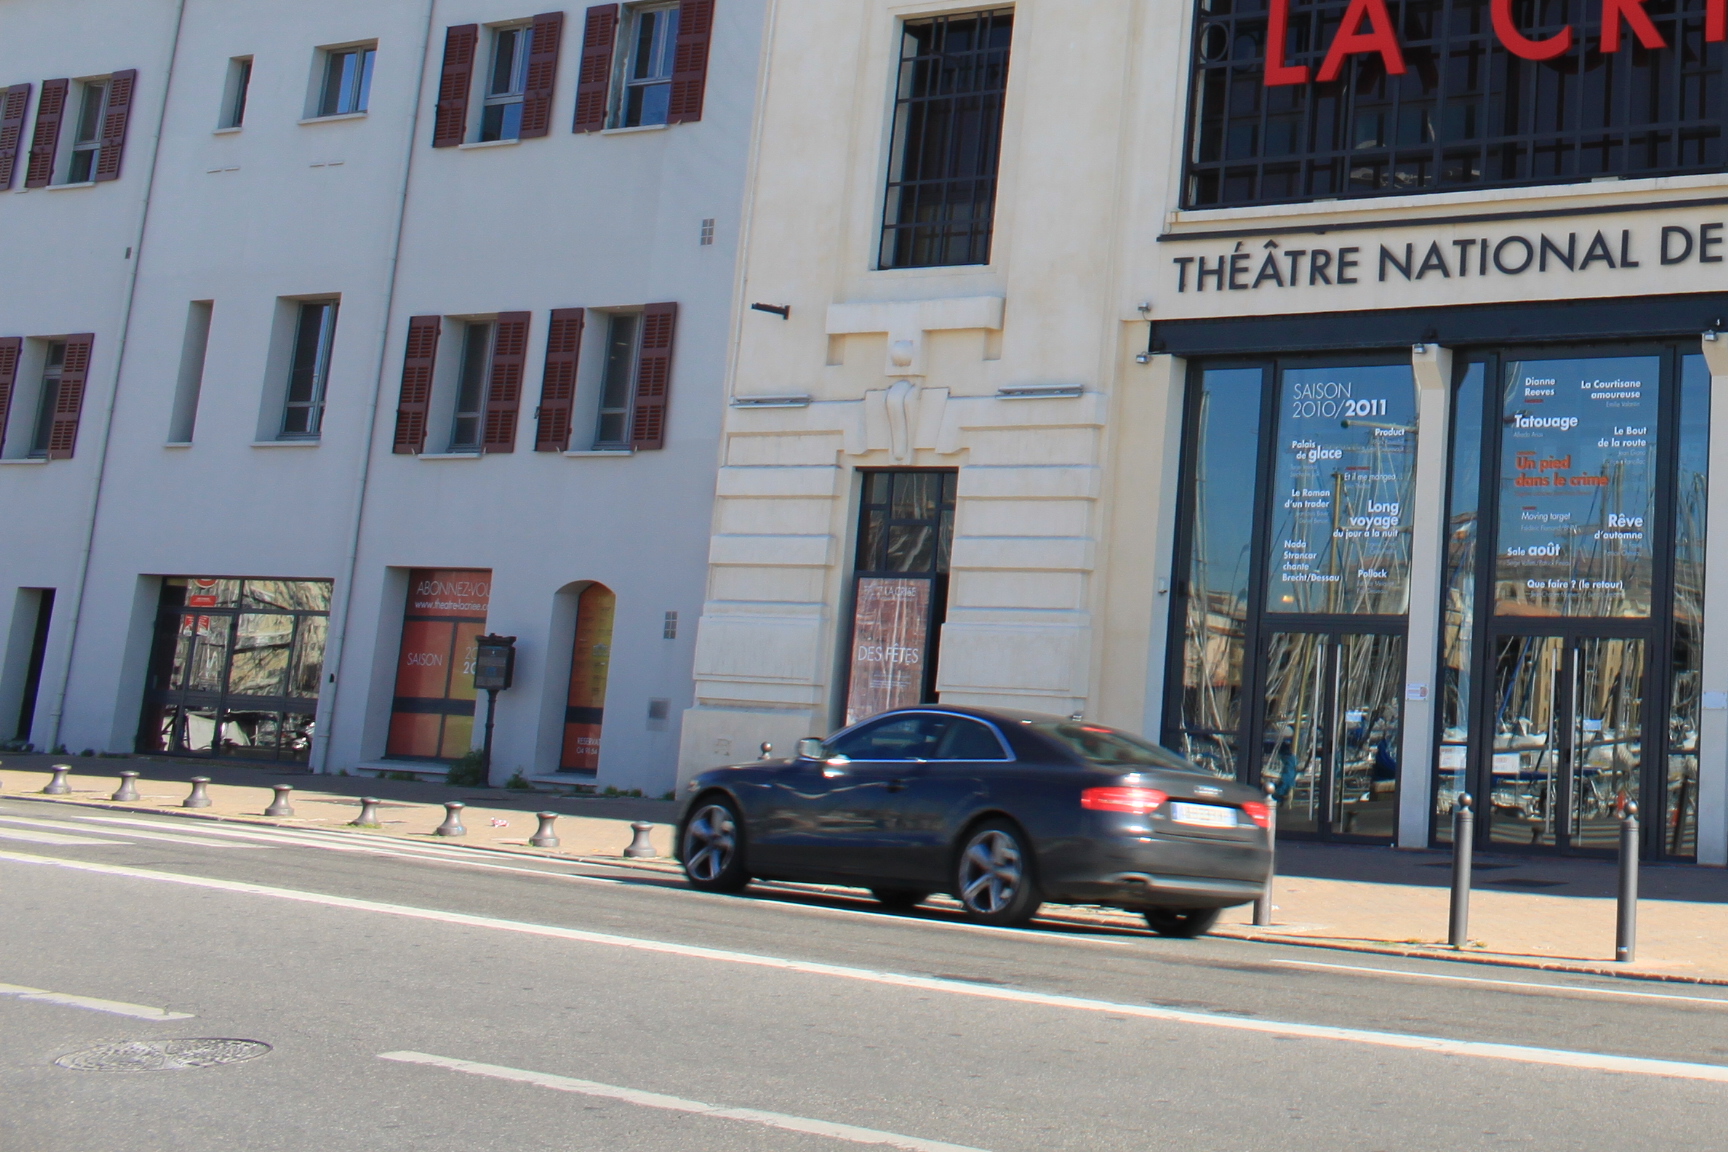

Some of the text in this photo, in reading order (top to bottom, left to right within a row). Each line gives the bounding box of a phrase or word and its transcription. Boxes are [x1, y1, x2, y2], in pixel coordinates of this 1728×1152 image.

[1173, 238, 1361, 293] THÉÂTRE
[1378, 229, 1640, 282] NATIONAL
[1660, 221, 1725, 265] DE
[1525, 377, 1556, 386] Dianne
[1581, 378, 1641, 389] La Courtisane
[1293, 381, 1352, 399] SAISON
[1524, 387, 1555, 396] Reeves
[1591, 390, 1641, 399] amoureuse
[1292, 399, 1387, 419] 2010/2011
[1514, 414, 1579, 430] Tatouage
[1374, 428, 1405, 436] Product
[1614, 427, 1647, 435] Le Bout
[1292, 439, 1316, 449] Palais
[1597, 437, 1647, 447] de la route
[1296, 445, 1343, 463] de glace
[1516, 454, 1571, 473] Un pied
[1515, 471, 1610, 487] dans le crime
[1292, 489, 1331, 497] Le Roman
[1284, 500, 1330, 508] d'un trader
[1368, 499, 1399, 515] Long
[1521, 512, 1571, 522] Moving target
[1608, 513, 1644, 528] Rêve
[1349, 515, 1399, 531] voyage
[1345, 530, 1362, 540] jour
[1371, 529, 1380, 537] la
[1381, 529, 1398, 537] nuit
[1594, 530, 1643, 539] d'automne
[1284, 540, 1307, 548] Nada
[1507, 542, 1561, 556] Sale août
[1283, 550, 1318, 559] Strancar
[1282, 562, 1310, 570] chante
[1282, 573, 1340, 582] Brecht/Dessau
[1357, 569, 1388, 578] Pollock
[1527, 579, 1623, 591] Que faire ? (le retour)
[857, 642, 919, 664] DES FÊTES
[407, 652, 443, 667] SAISON
